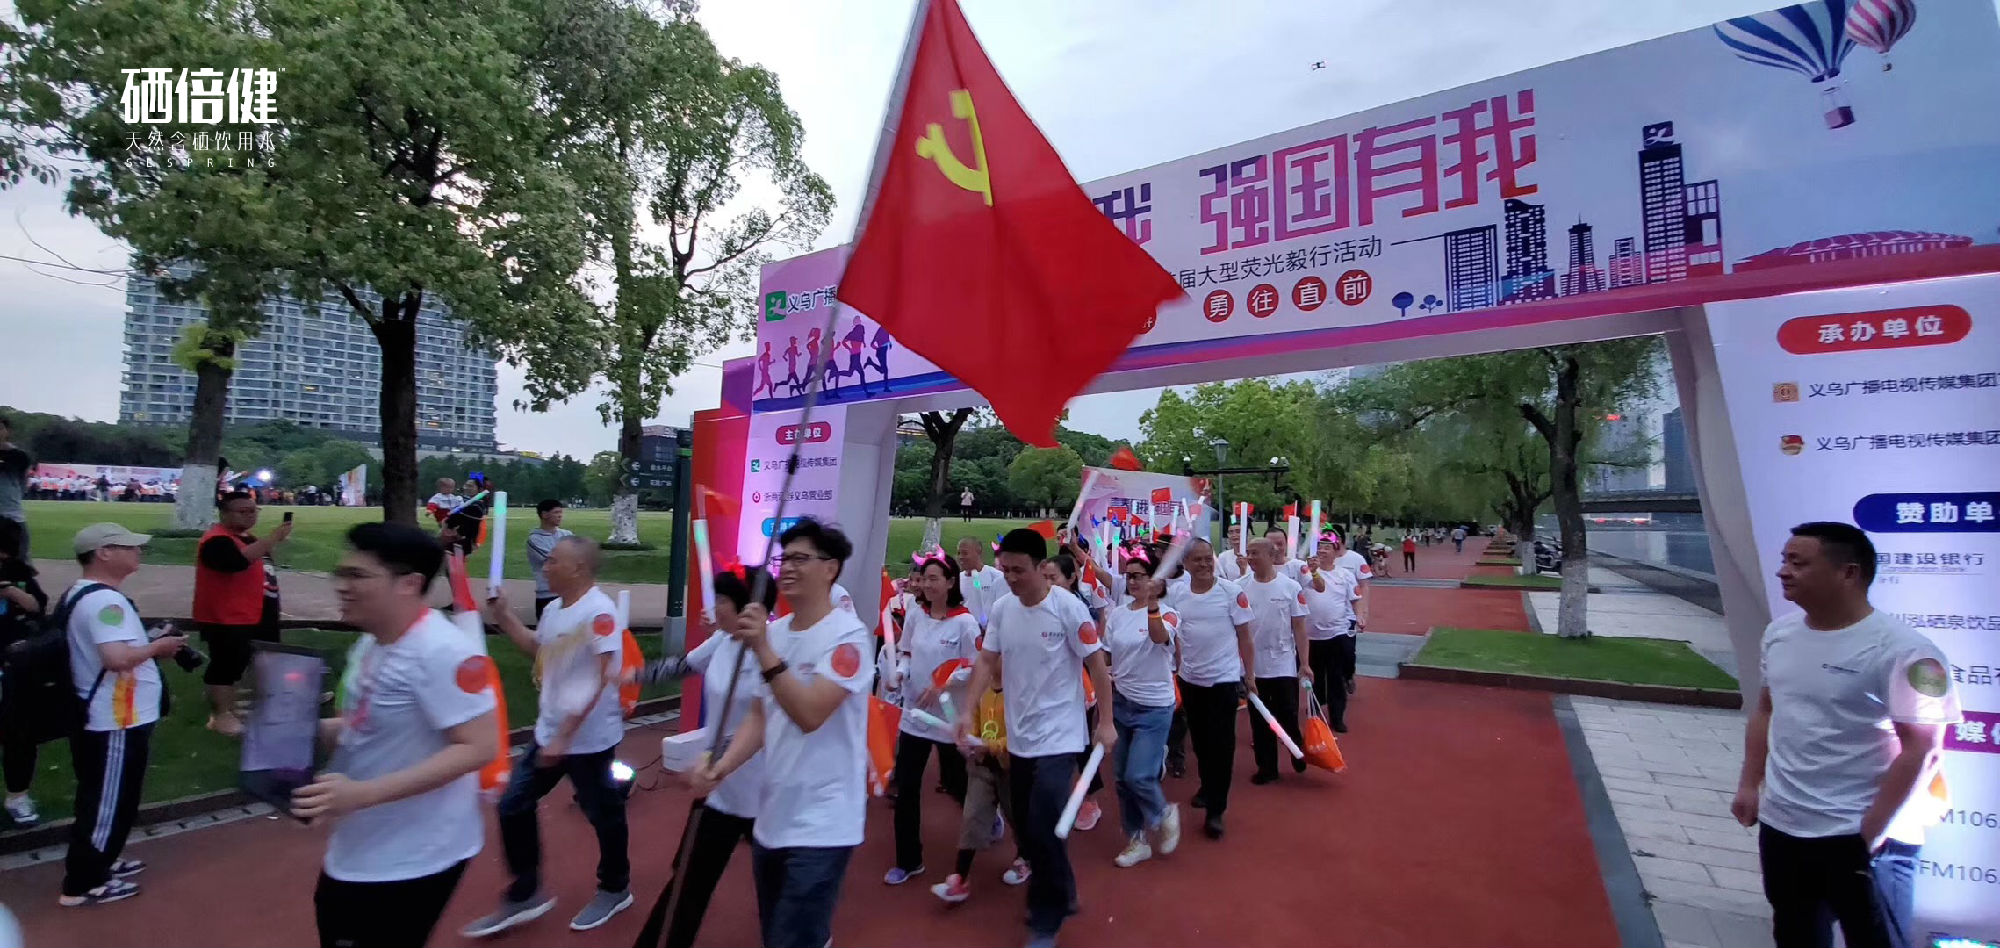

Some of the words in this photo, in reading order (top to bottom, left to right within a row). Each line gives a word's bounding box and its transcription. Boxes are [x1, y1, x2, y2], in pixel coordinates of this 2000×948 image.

[1199, 88, 1538, 256] 强国有我
[1173, 234, 1382, 289] 届大型荧光毅行活动
[1210, 275, 1368, 318] 勇往直前
[1818, 315, 1944, 343] 承办单位
[1808, 372, 2000, 398] 义乌广播电视传媒集团
[1896, 501, 2000, 524] 赞助单
[1950, 664, 2000, 685] 食品
